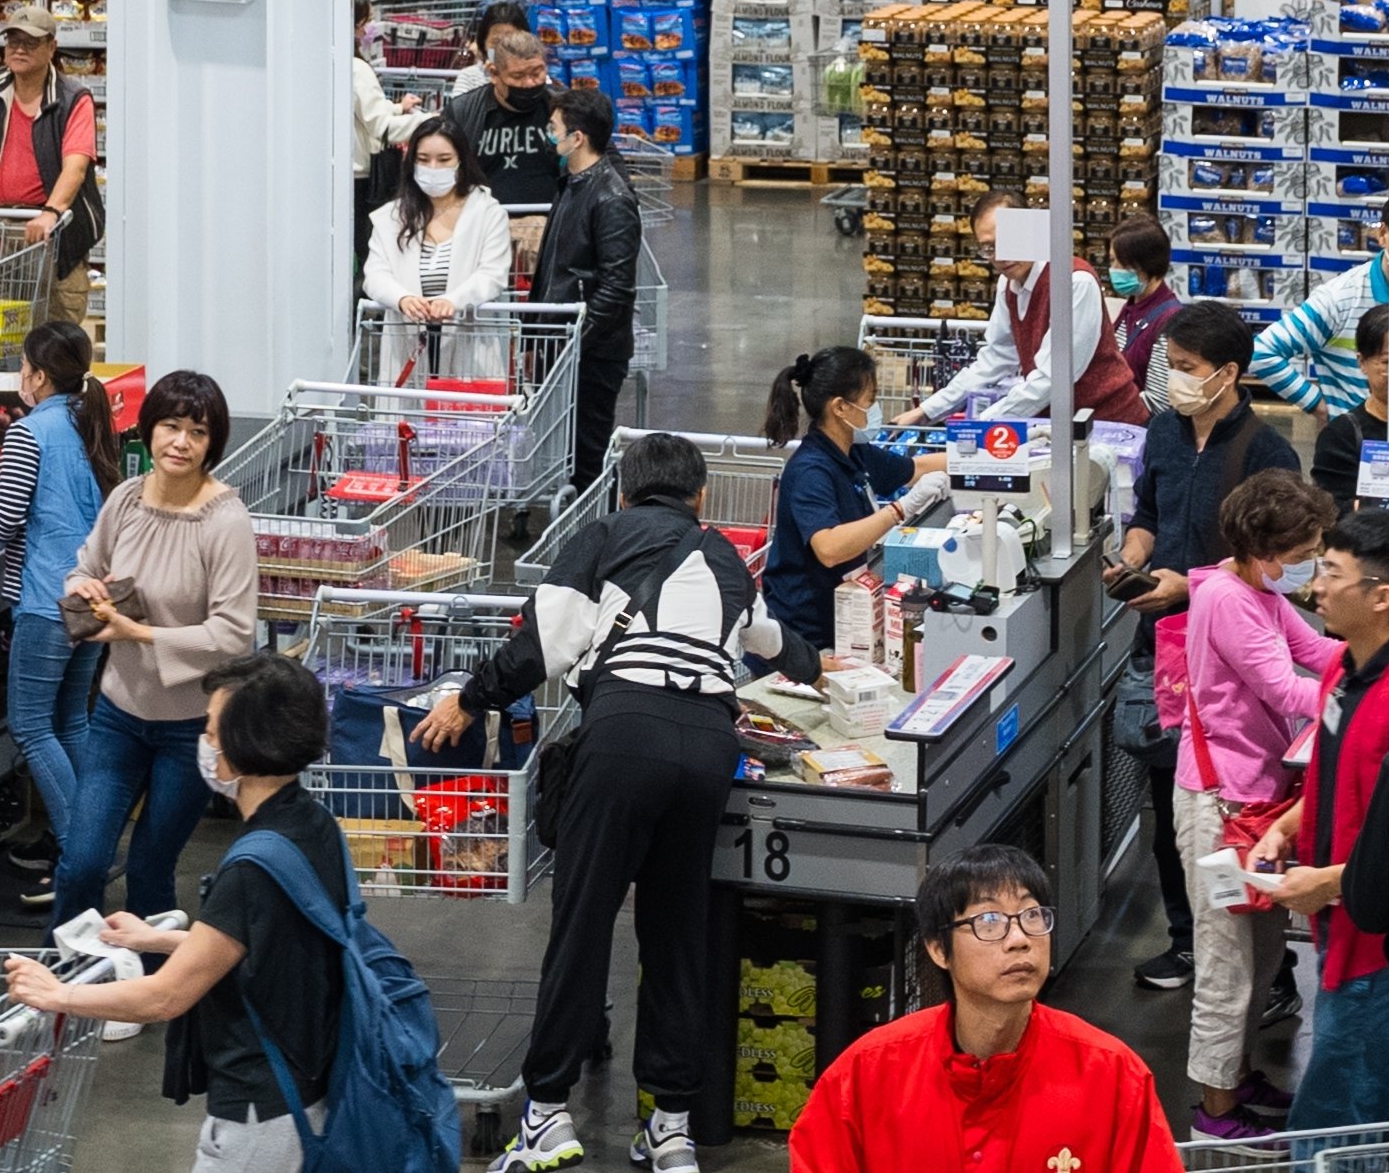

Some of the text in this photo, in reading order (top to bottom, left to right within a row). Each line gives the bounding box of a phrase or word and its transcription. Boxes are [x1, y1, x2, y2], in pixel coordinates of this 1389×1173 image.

[1206, 94, 1265, 105] WALNUTS
[1204, 148, 1262, 159] WALNUTS
[1202, 202, 1260, 213] WALNUTS
[1203, 255, 1261, 266] WALNUTS
[734, 829, 790, 882] 18
[739, 988, 774, 998] DLESS
[737, 1047, 776, 1060] DLESS
[734, 1101, 776, 1113] EDLESS
